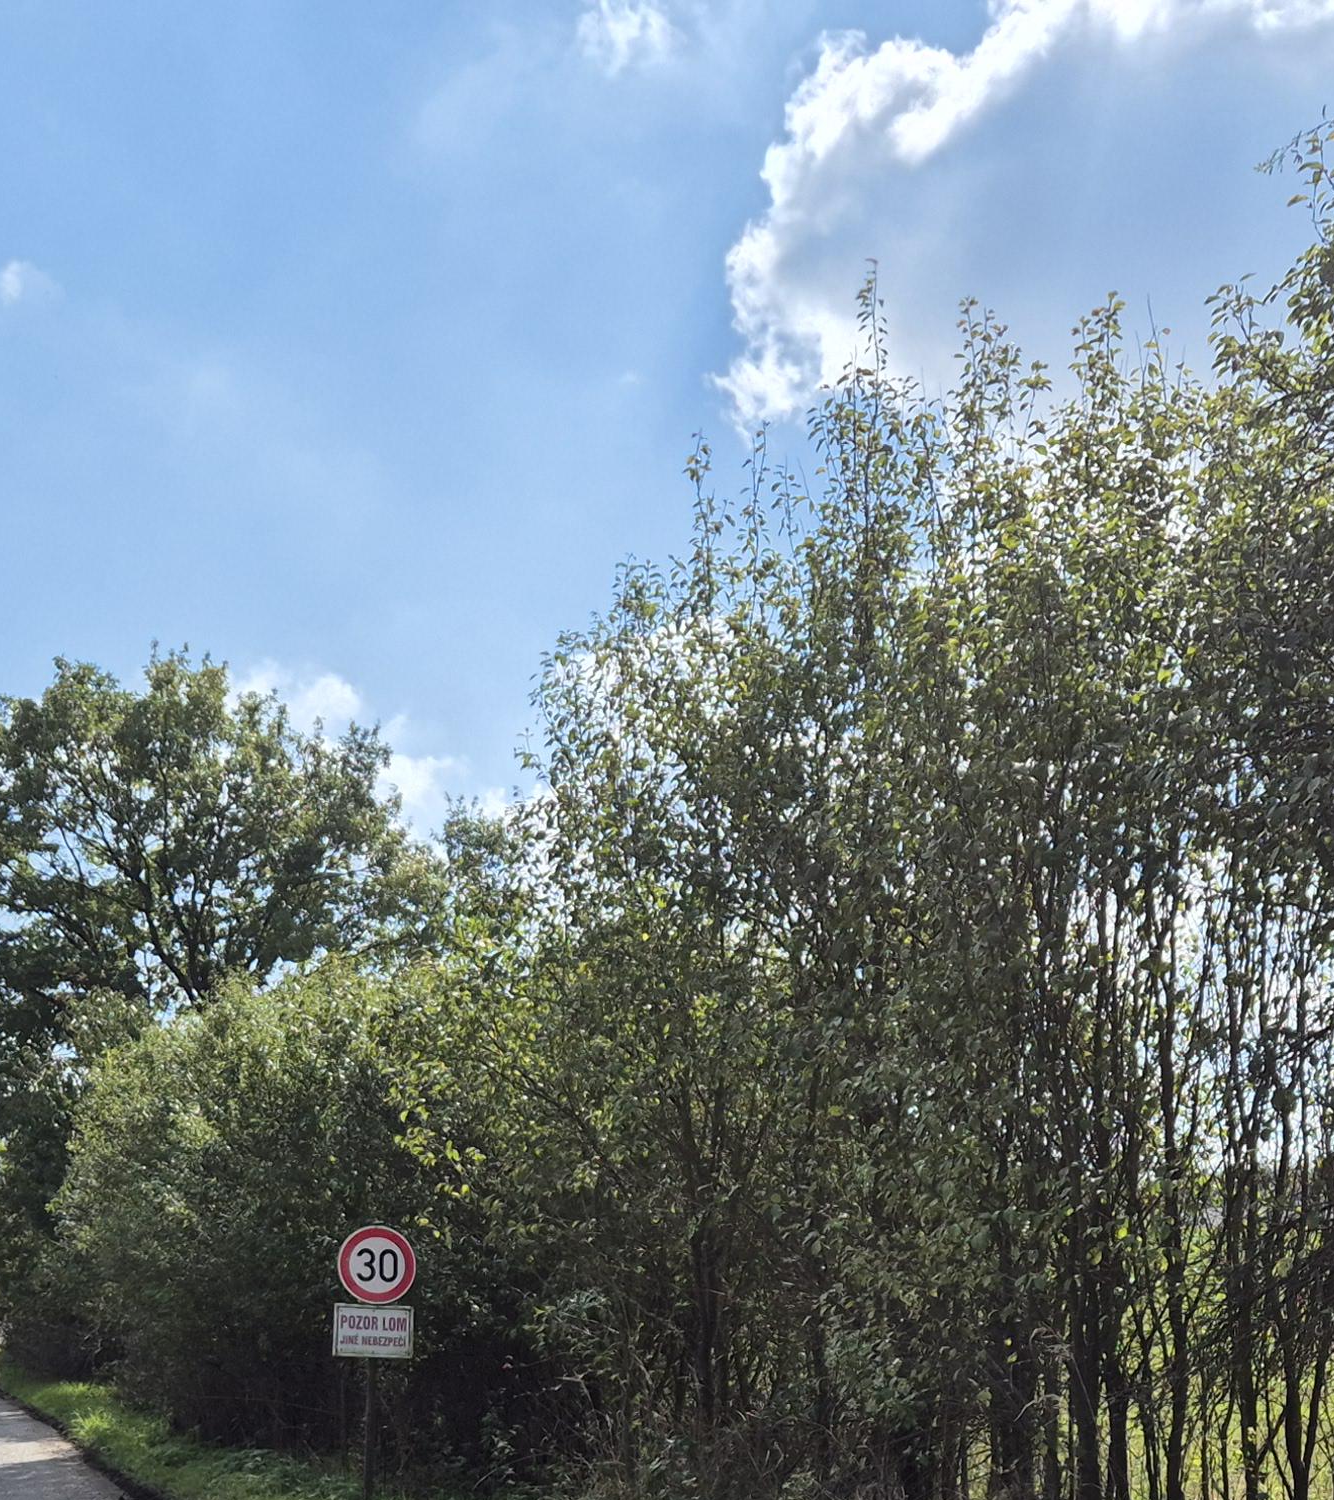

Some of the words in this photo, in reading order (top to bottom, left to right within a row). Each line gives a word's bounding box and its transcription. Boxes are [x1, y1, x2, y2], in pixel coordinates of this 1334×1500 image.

[356, 1248, 398, 1283] 30
[340, 1314, 378, 1331] POZOR
[383, 1318, 407, 1332] LOM
[340, 1333, 358, 1345] JINÉ
